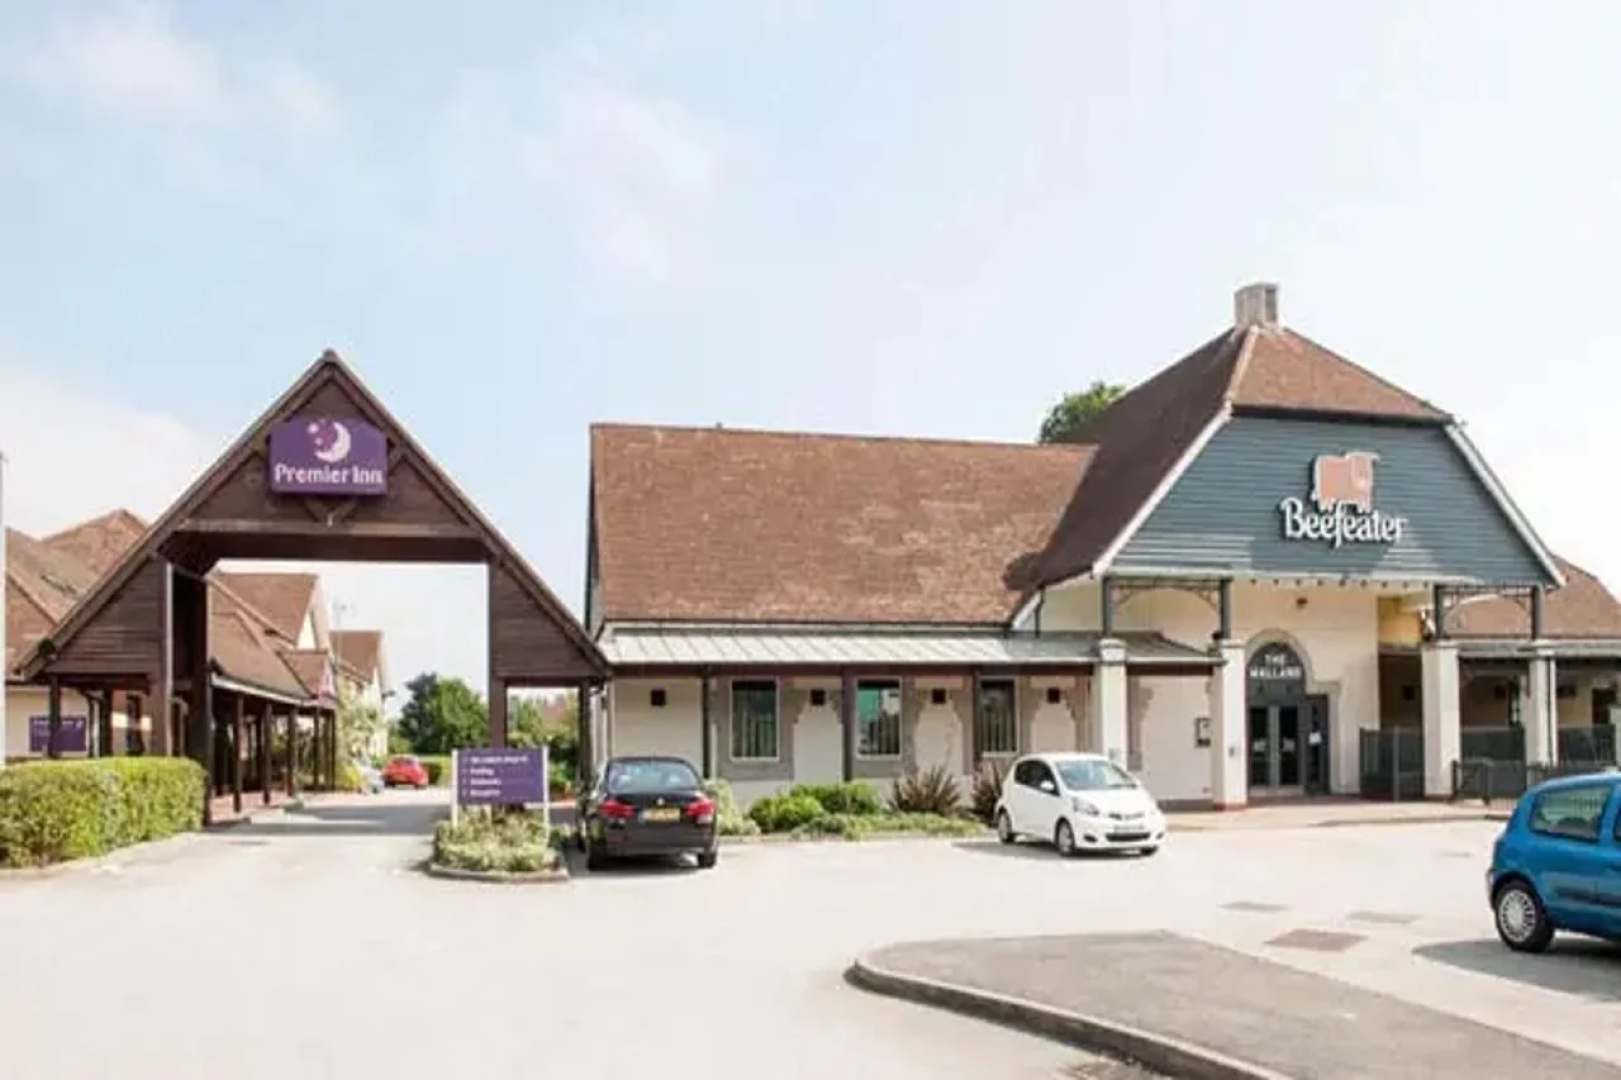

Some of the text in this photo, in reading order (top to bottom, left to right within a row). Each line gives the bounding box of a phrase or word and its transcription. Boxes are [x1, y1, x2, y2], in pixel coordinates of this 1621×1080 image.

[274, 463, 383, 484] Premier Inn
[1281, 497, 1409, 549] Beefeater
[1264, 653, 1286, 666] THE
